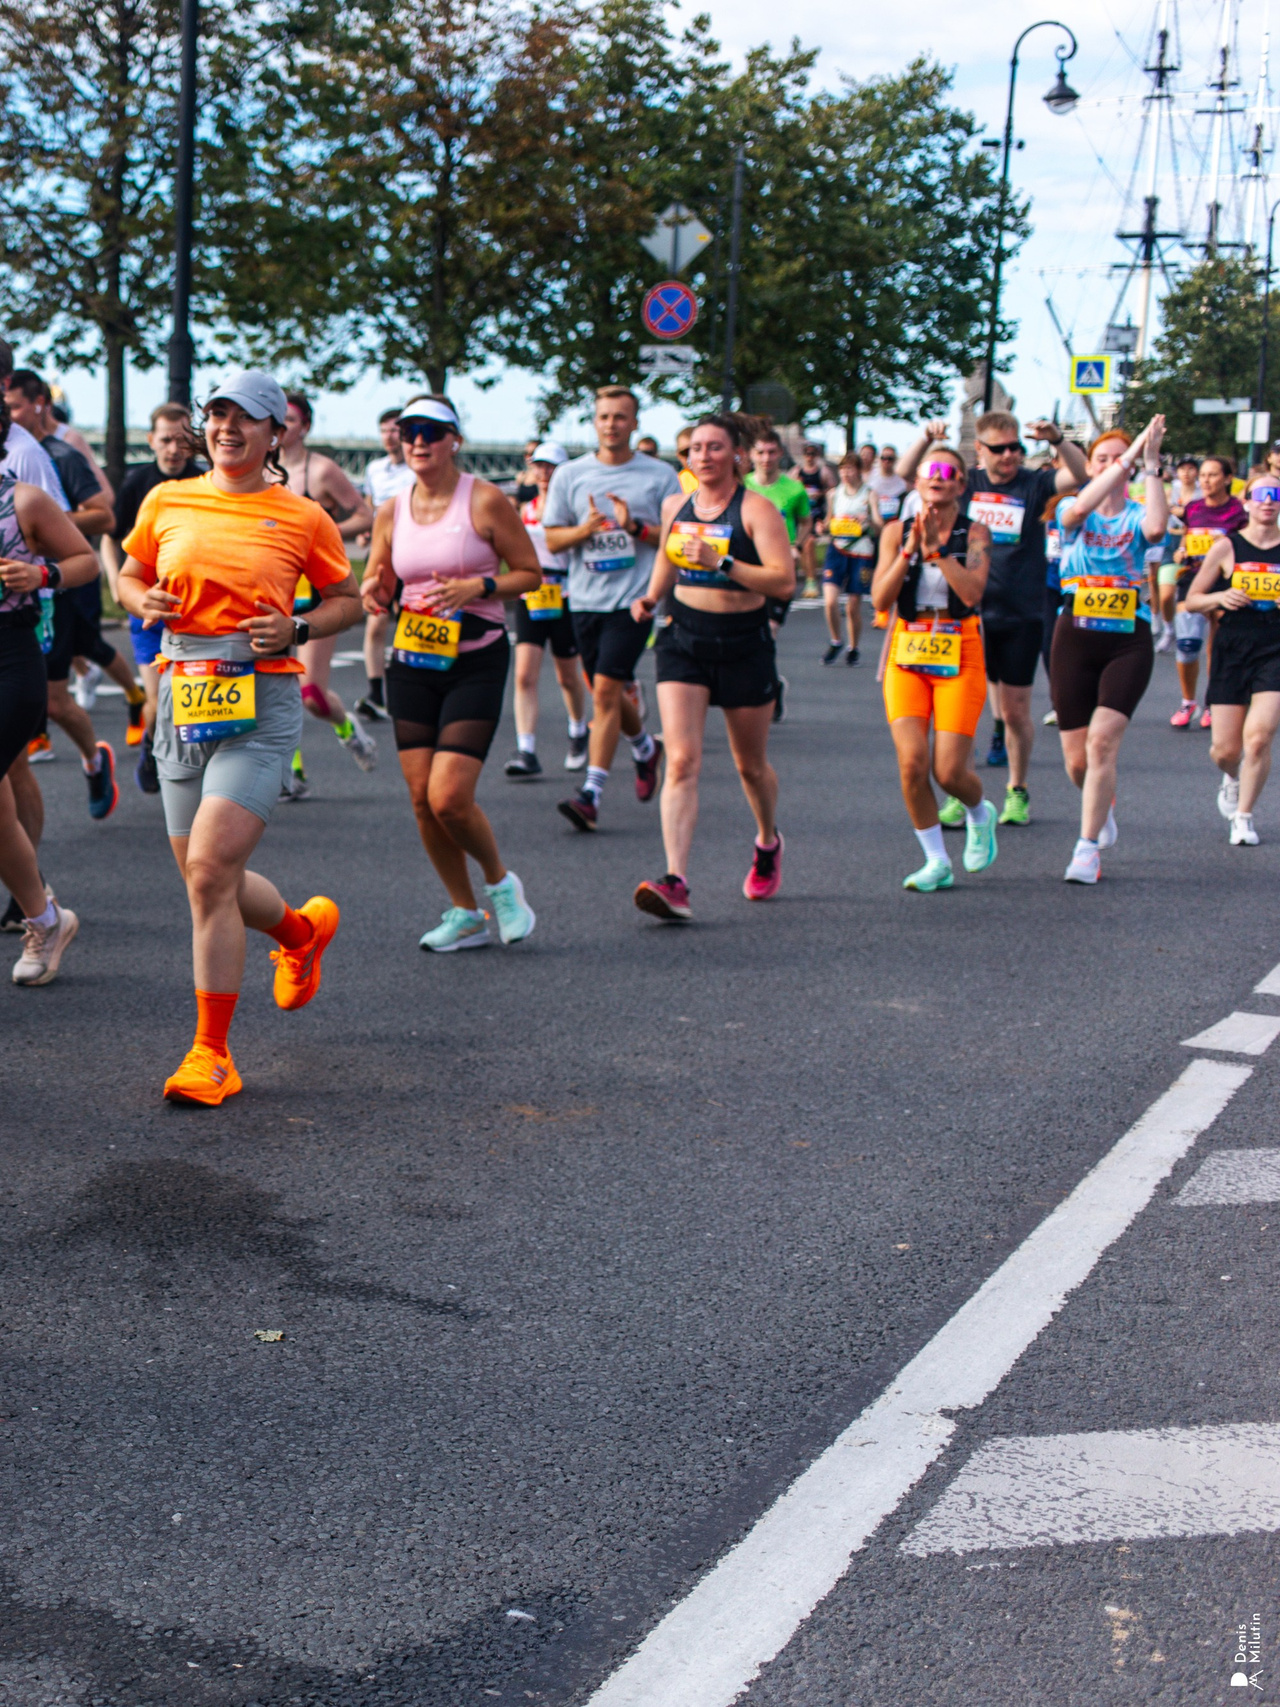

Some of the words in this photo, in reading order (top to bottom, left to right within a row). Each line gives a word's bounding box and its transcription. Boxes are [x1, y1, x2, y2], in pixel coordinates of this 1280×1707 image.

[976, 509, 1014, 527] 7024
[1084, 592, 1130, 610] 6929
[403, 618, 450, 645] 6428
[907, 637, 952, 656] 6452
[181, 682, 242, 708] 3746
[187, 708, 234, 718] МАРГАРИТА
[179, 726, 188, 742] E
